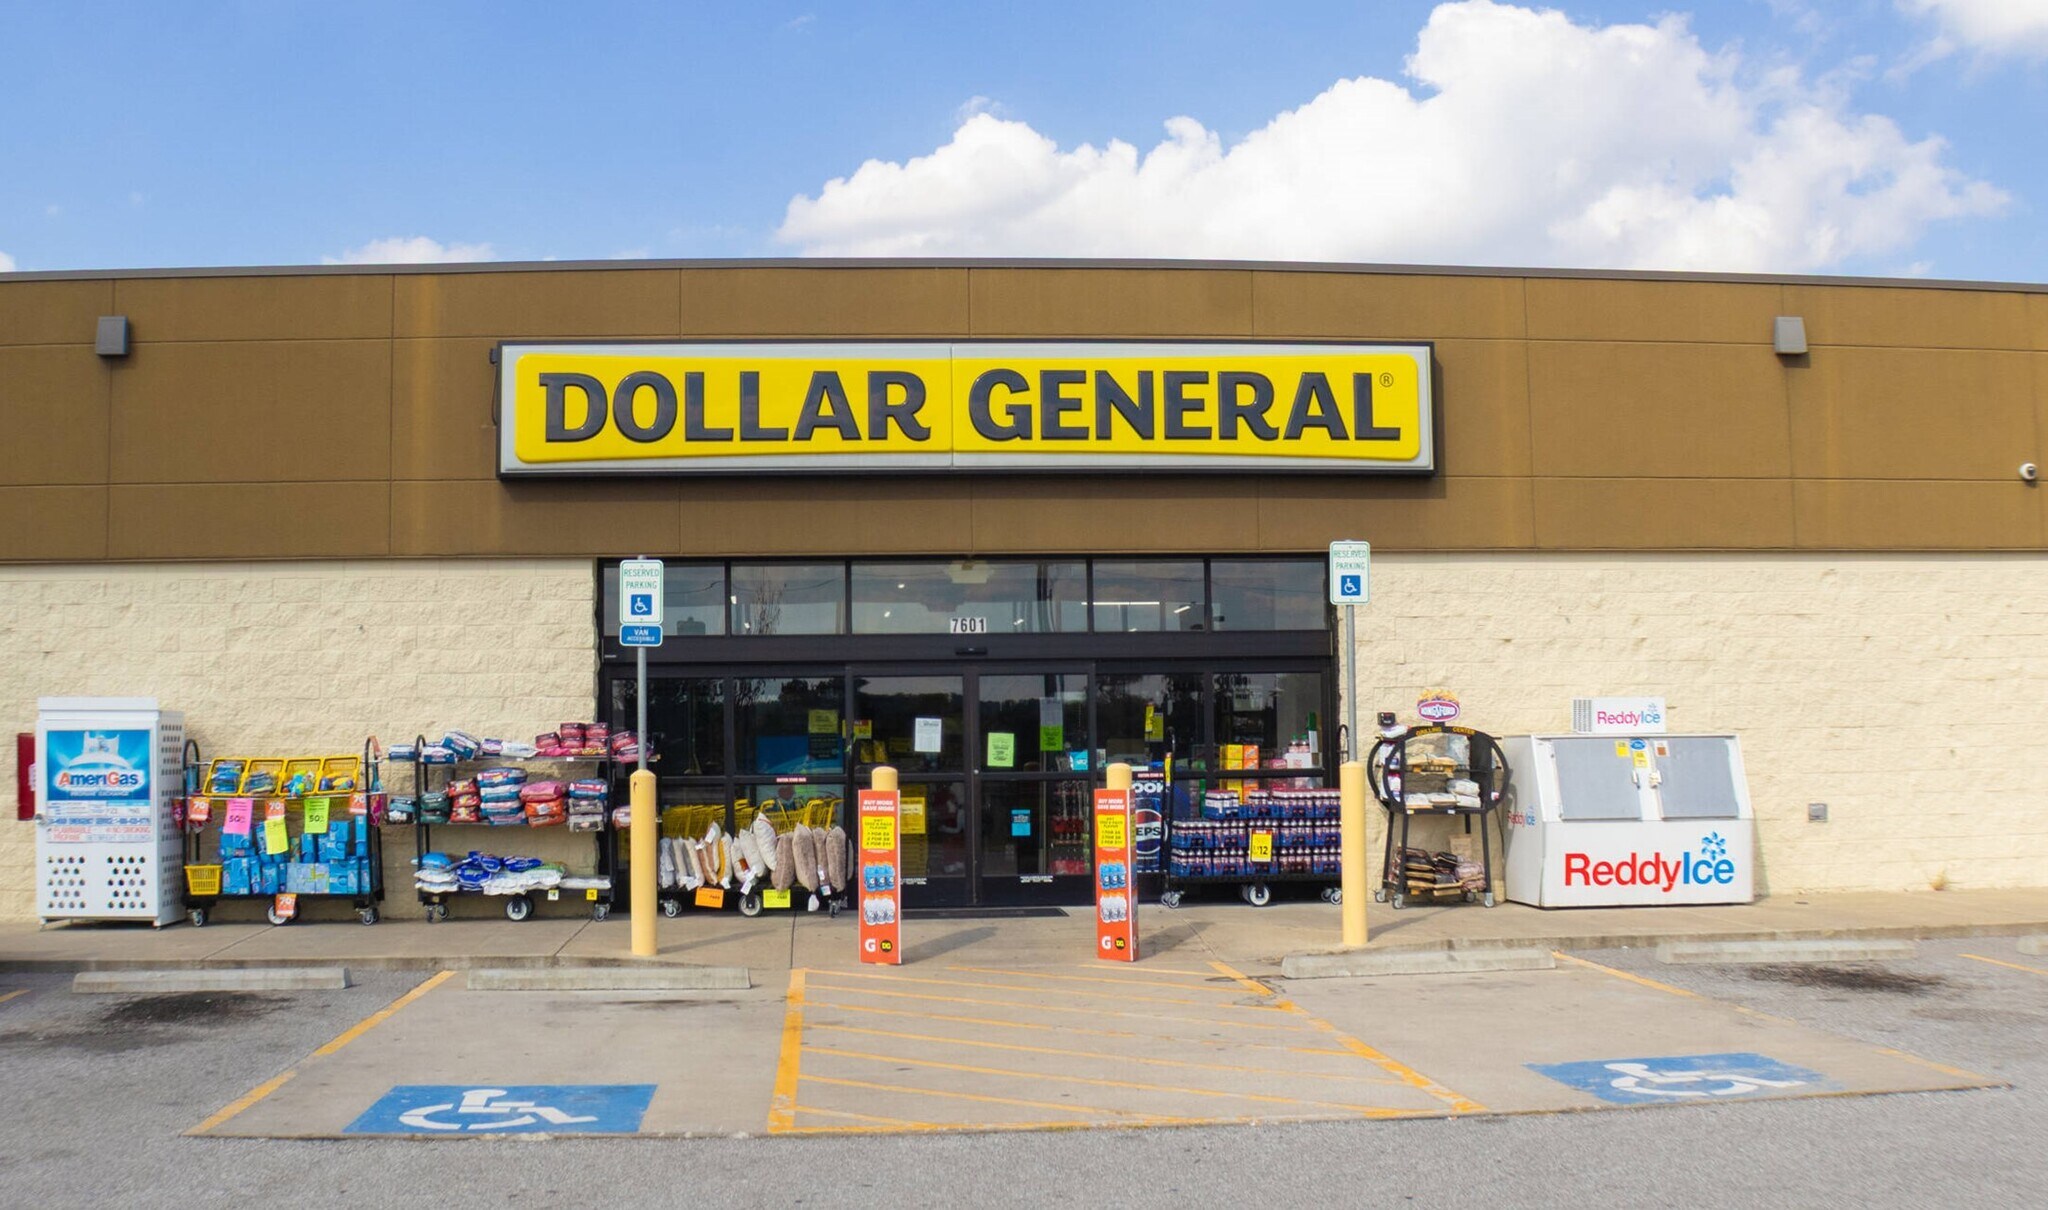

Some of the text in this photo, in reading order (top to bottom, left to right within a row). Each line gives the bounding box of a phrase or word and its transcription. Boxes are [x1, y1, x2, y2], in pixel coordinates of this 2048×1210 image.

[539, 370, 931, 443] DOLLAR
[1333, 550, 1367, 558] RESERVED
[1336, 562, 1366, 570] PARKING
[623, 568, 659, 577] RESERVED
[626, 581, 657, 589] PARKING
[952, 618, 984, 632] 7601
[1452, 727, 1476, 736] CENTER
[58, 771, 139, 787] AmeriGas
[1136, 827, 1161, 836] EPS
[864, 938, 877, 952] G
[1101, 936, 1111, 949] G
